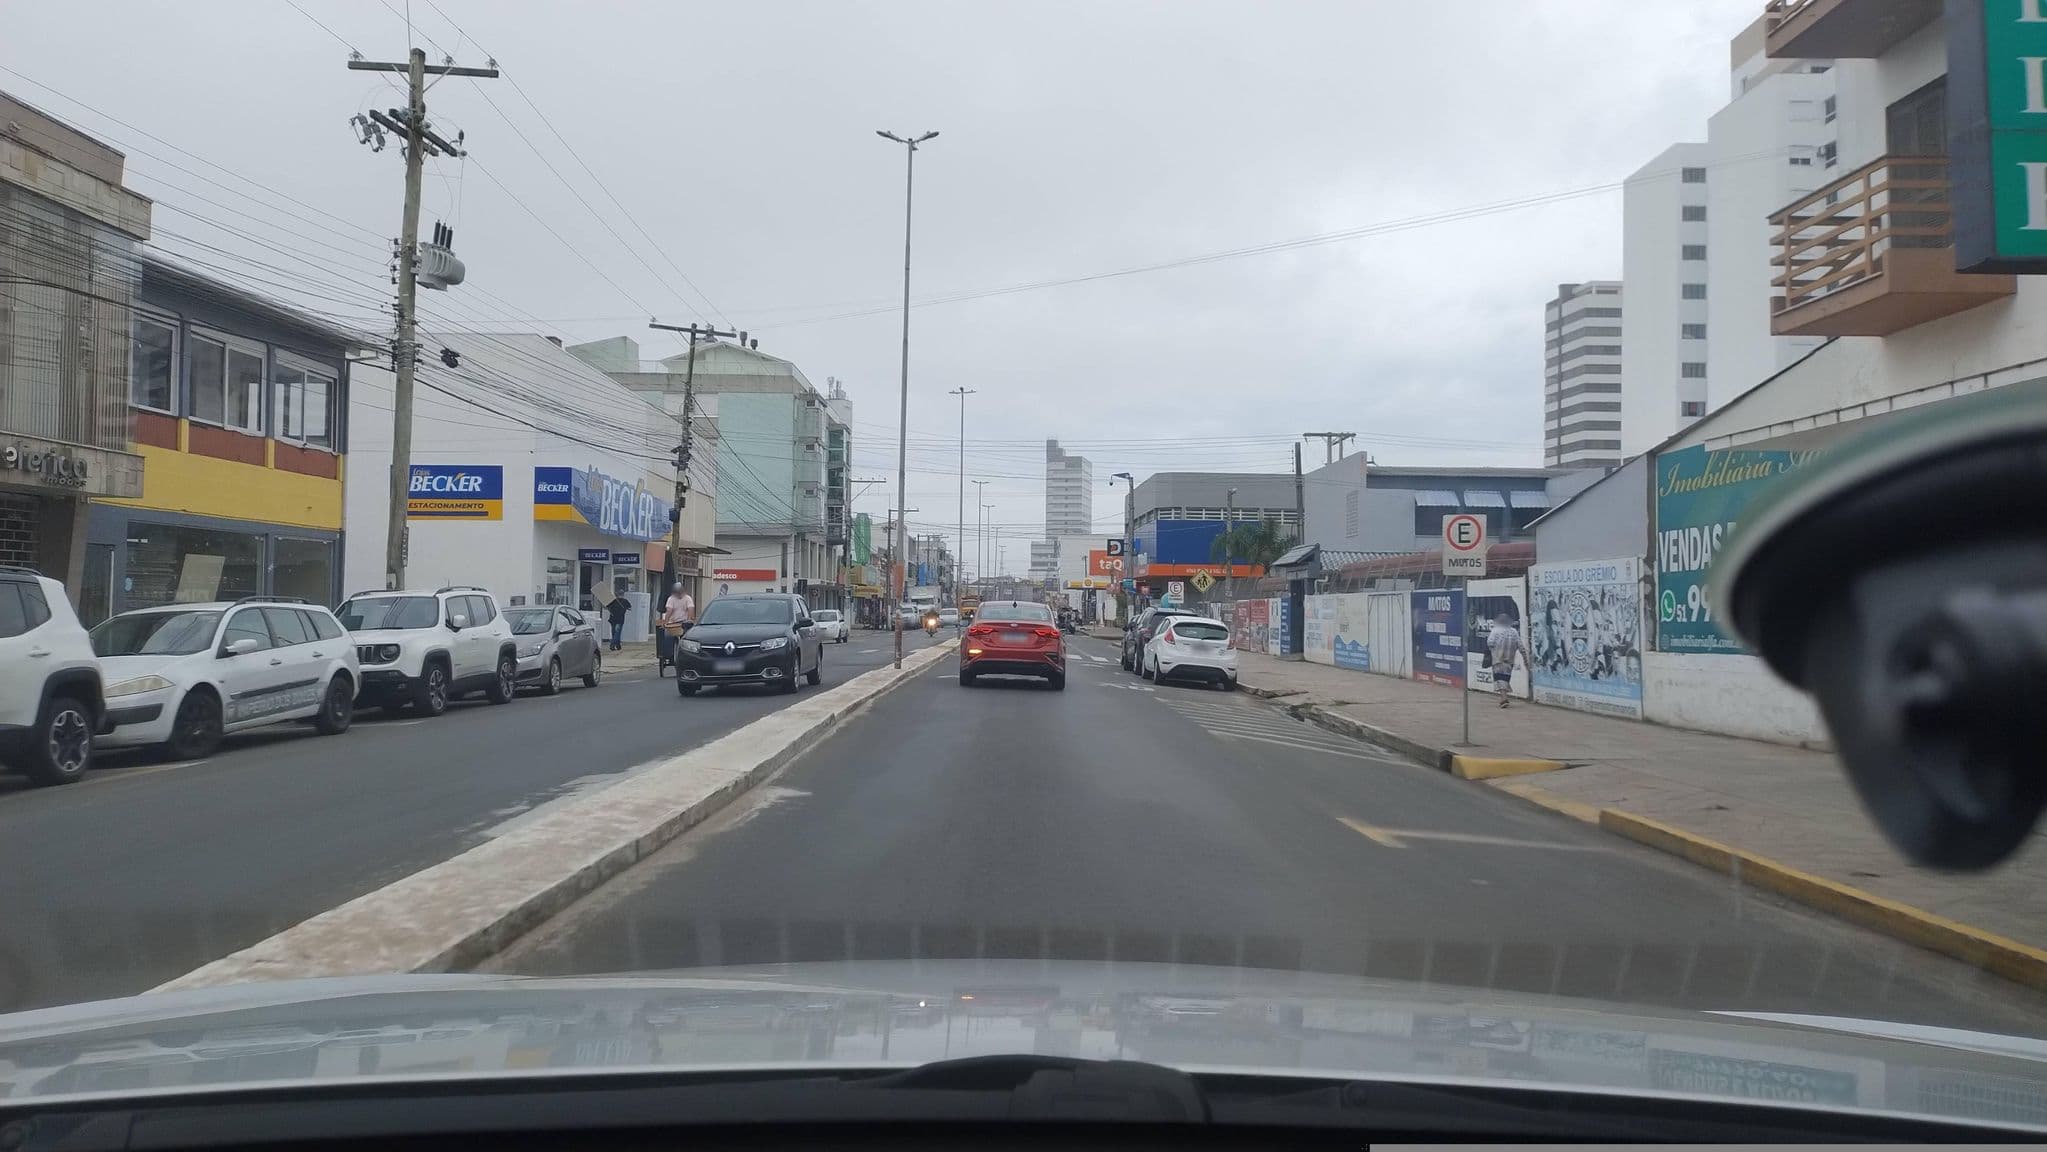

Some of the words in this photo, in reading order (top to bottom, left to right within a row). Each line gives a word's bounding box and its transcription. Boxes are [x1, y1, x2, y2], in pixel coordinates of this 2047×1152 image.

[409, 472, 482, 492] BECKER
[537, 483, 568, 493] BECKER
[408, 502, 485, 510] ESTACIONAMENTO
[599, 477, 654, 539] BECKER
[1458, 522, 1471, 544] E
[1658, 523, 1723, 573] VENDAS
[1448, 558, 1483, 568] MOTOS
[1544, 570, 1571, 584] ESCOLA
[1572, 568, 1584, 582] DO
[1427, 595, 1452, 612] MATOS
[1676, 604, 1688, 623] 51
